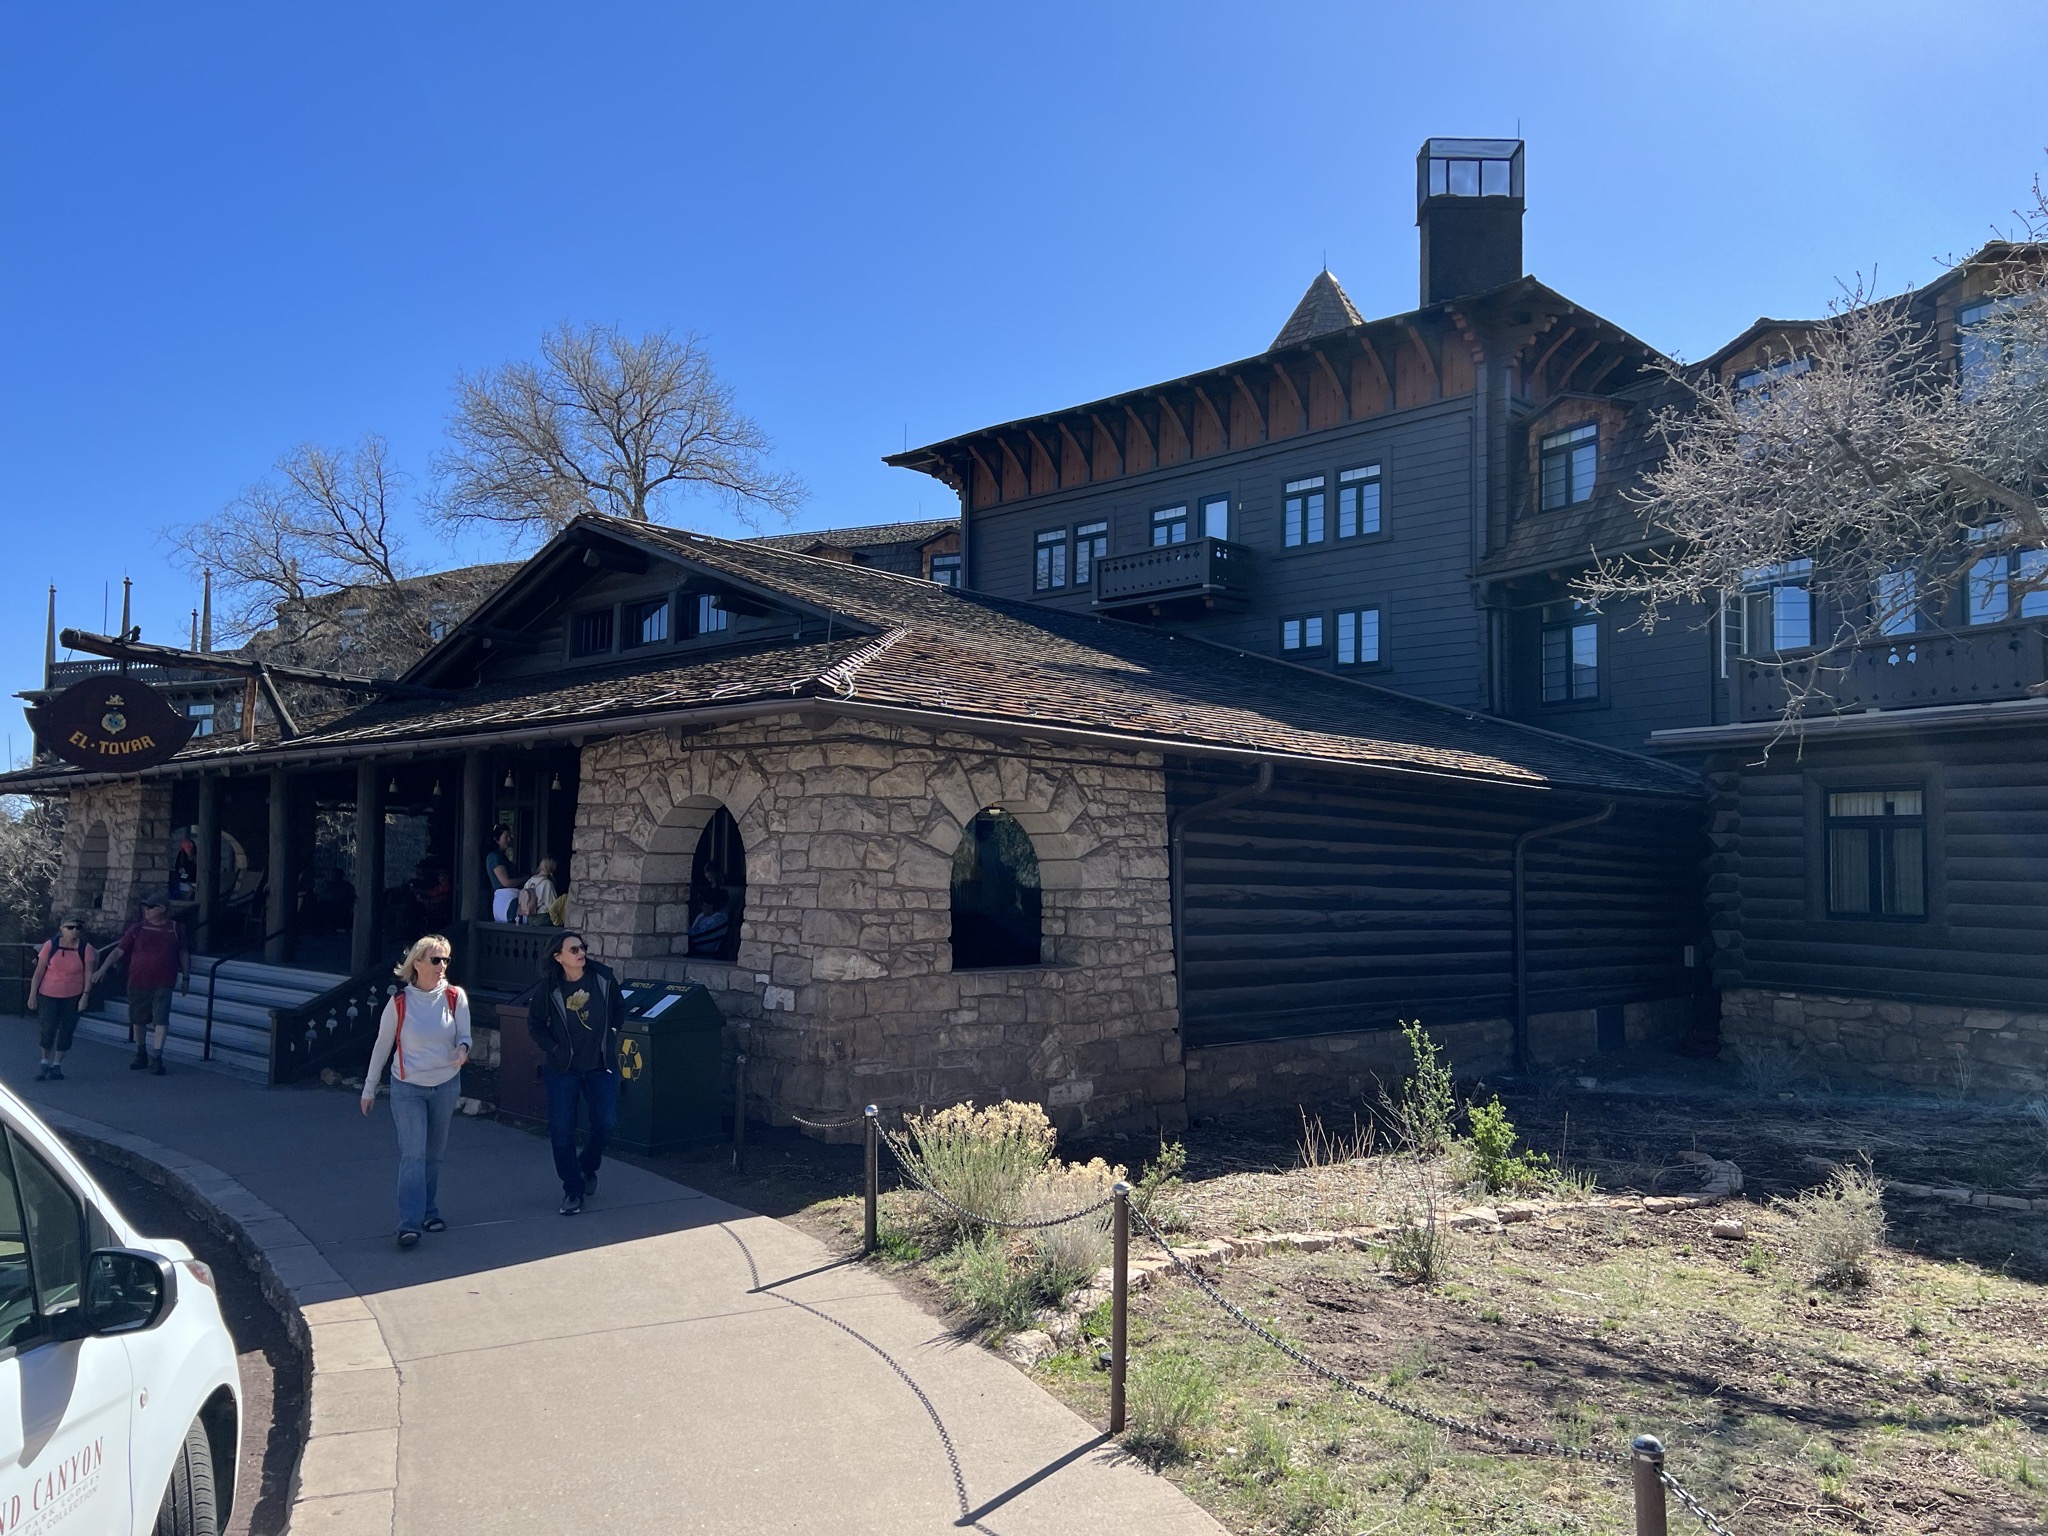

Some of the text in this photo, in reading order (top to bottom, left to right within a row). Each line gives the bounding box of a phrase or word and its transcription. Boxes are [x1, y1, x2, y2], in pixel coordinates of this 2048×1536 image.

[69, 730, 156, 755] EL TOVAR
[631, 981, 656, 989] RECYCLE
[665, 984, 692, 992] RECYCLE
[33, 1436, 103, 1511] CANYON
[25, 1473, 100, 1534] PARK LODGES
[47, 1485, 98, 1529] COLLECTION
